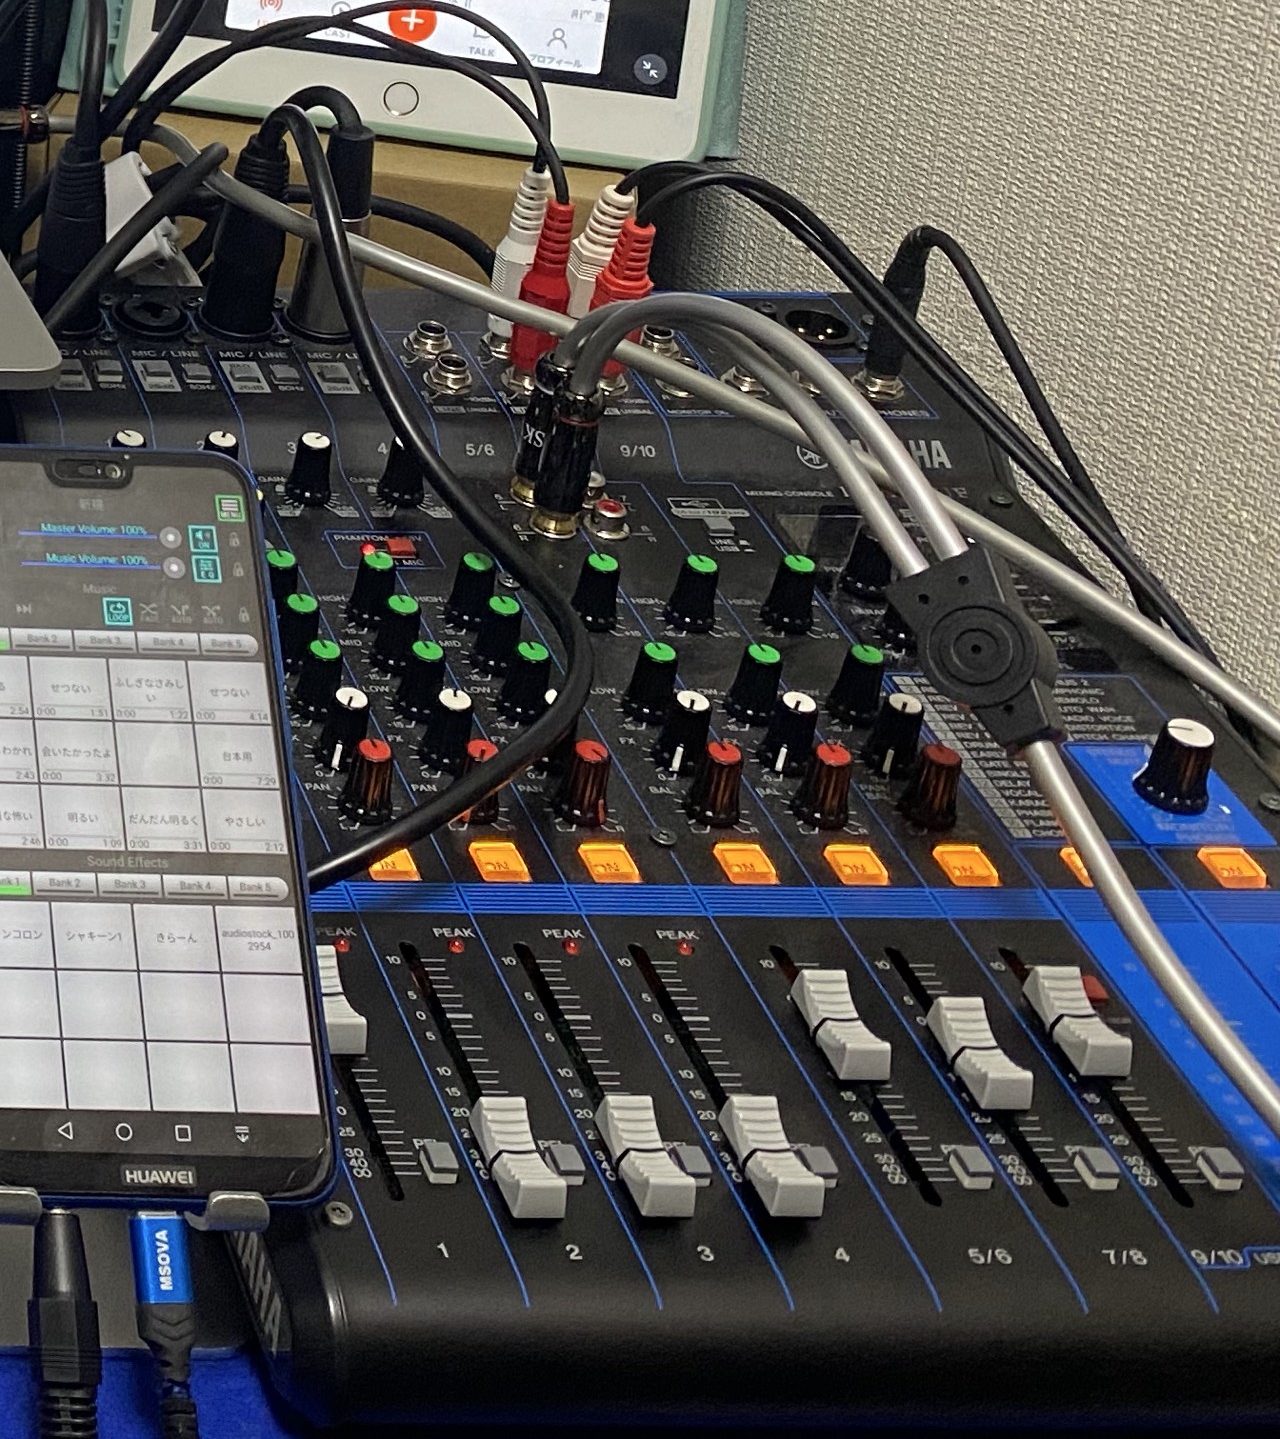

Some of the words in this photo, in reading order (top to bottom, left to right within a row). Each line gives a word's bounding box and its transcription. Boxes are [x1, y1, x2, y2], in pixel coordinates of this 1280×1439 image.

[469, 46, 495, 57] TALK
[465, 443, 495, 457] 5/6
[620, 443, 656, 458] 9/10
[40, 522, 75, 533] Master
[46, 553, 75, 563] Music
[51, 683, 91, 694] せつない
[210, 687, 250, 698] せつない
[225, 816, 266, 827] やさしい
[433, 927, 475, 939] PEAK
[542, 928, 585, 940] PEAK
[656, 929, 699, 941] PEAK
[125, 1168, 195, 1185] HUAWEI
[437, 1242, 450, 1258] 1
[566, 1244, 583, 1260] 2
[697, 1246, 715, 1262] 3
[835, 1249, 850, 1262] 4
[157, 1229, 173, 1291] MSOVA
[968, 1249, 1012, 1265] 5/6
[1102, 1249, 1147, 1265] 7/8
[1191, 1249, 1244, 1265] 9/10
